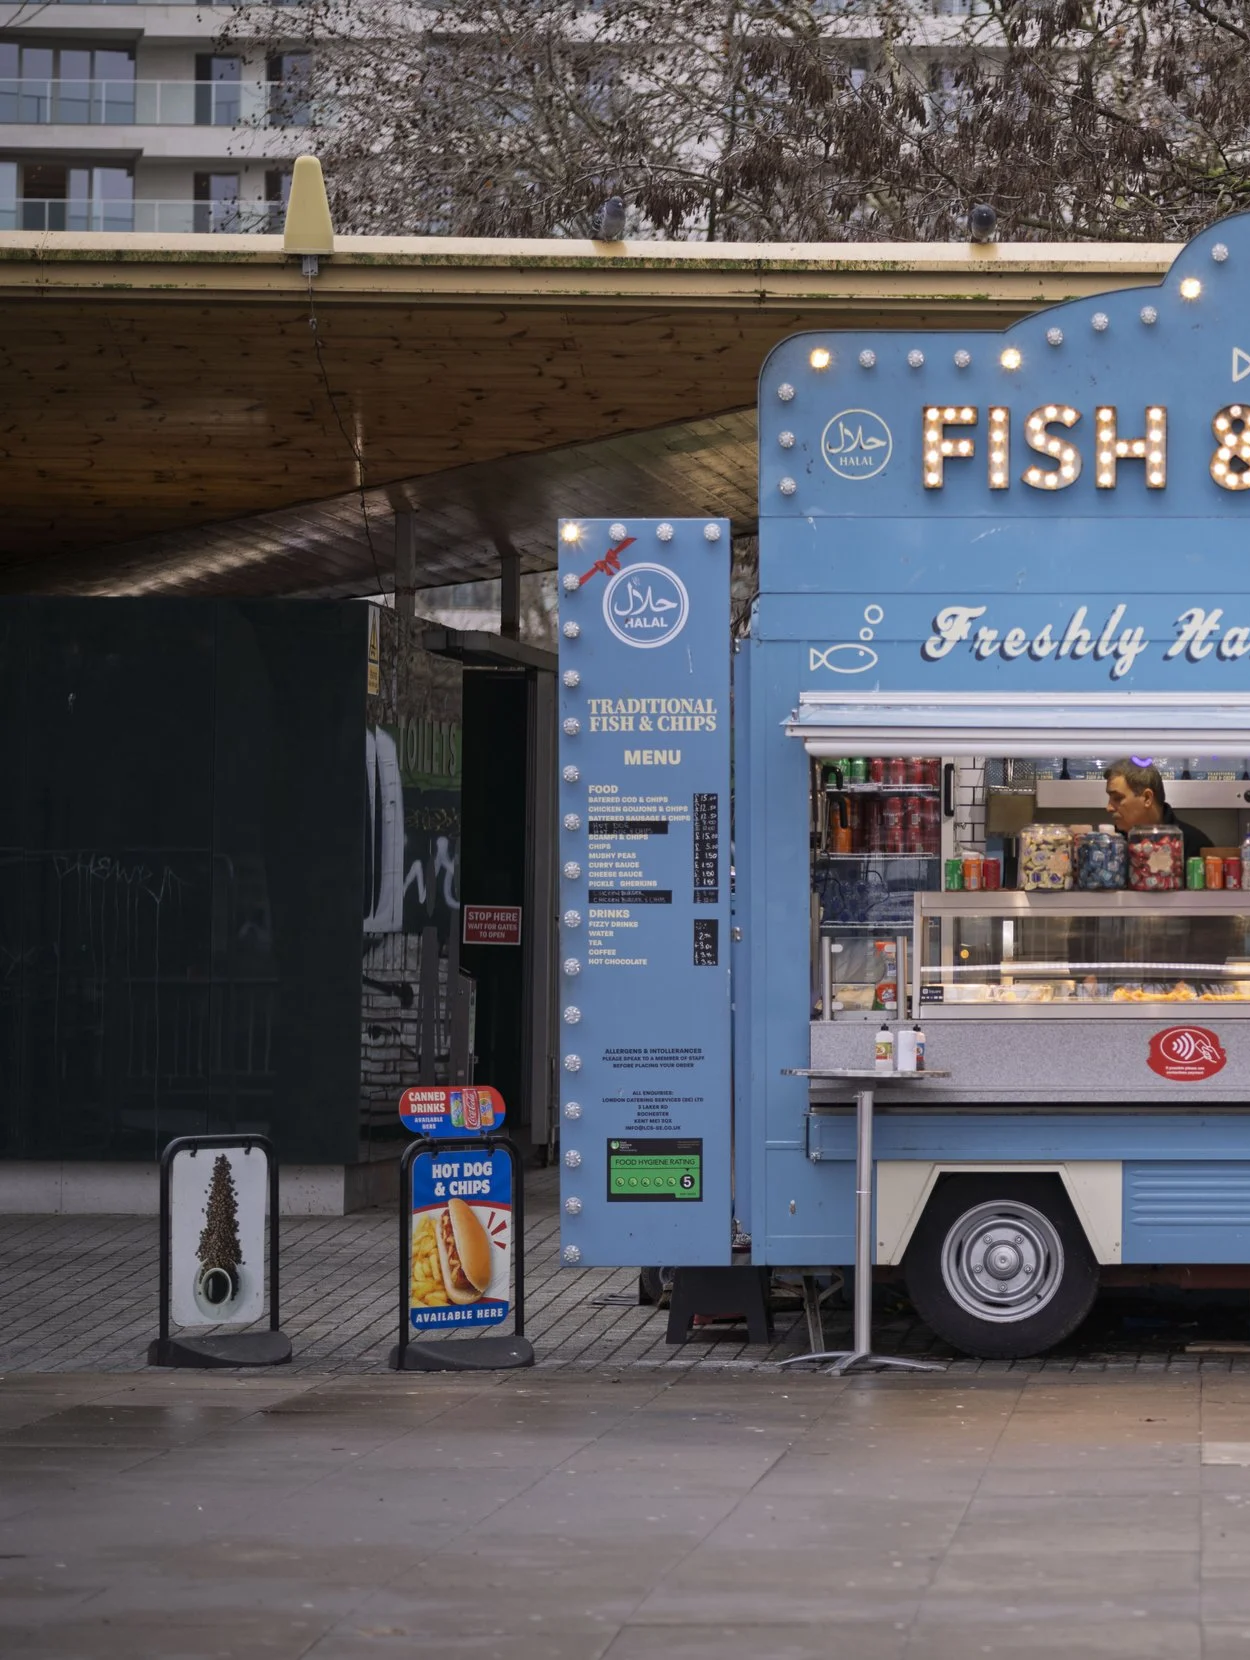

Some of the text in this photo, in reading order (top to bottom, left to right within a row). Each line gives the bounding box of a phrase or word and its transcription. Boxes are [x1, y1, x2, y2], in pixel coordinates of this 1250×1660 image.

[825, 420, 888, 454] حلال
[922, 404, 1168, 490] FISH
[839, 456, 874, 467] HALAL
[613, 582, 679, 617] حلال
[624, 616, 669, 629] HALAL
[920, 603, 1151, 679] Freshly
[587, 698, 718, 716] TRADITIONAL
[588, 715, 717, 733] FISH & CHIPS
[398, 715, 457, 777] TOILETS
[623, 749, 682, 766] MENU
[588, 785, 619, 794] FOOD
[468, 912, 518, 921] STOP HERE
[589, 909, 630, 918] DRINKS
[408, 1091, 446, 1102] CANNED
[410, 1103, 446, 1113] DRINKS
[431, 1161, 493, 1179] HOT DOG
[615, 1158, 696, 1166] FOOD HYGIENE RATING
[434, 1179, 491, 1197] & CHIPS
[683, 1176, 692, 1188] 5
[415, 1307, 504, 1323] AVAILABLE HERE
